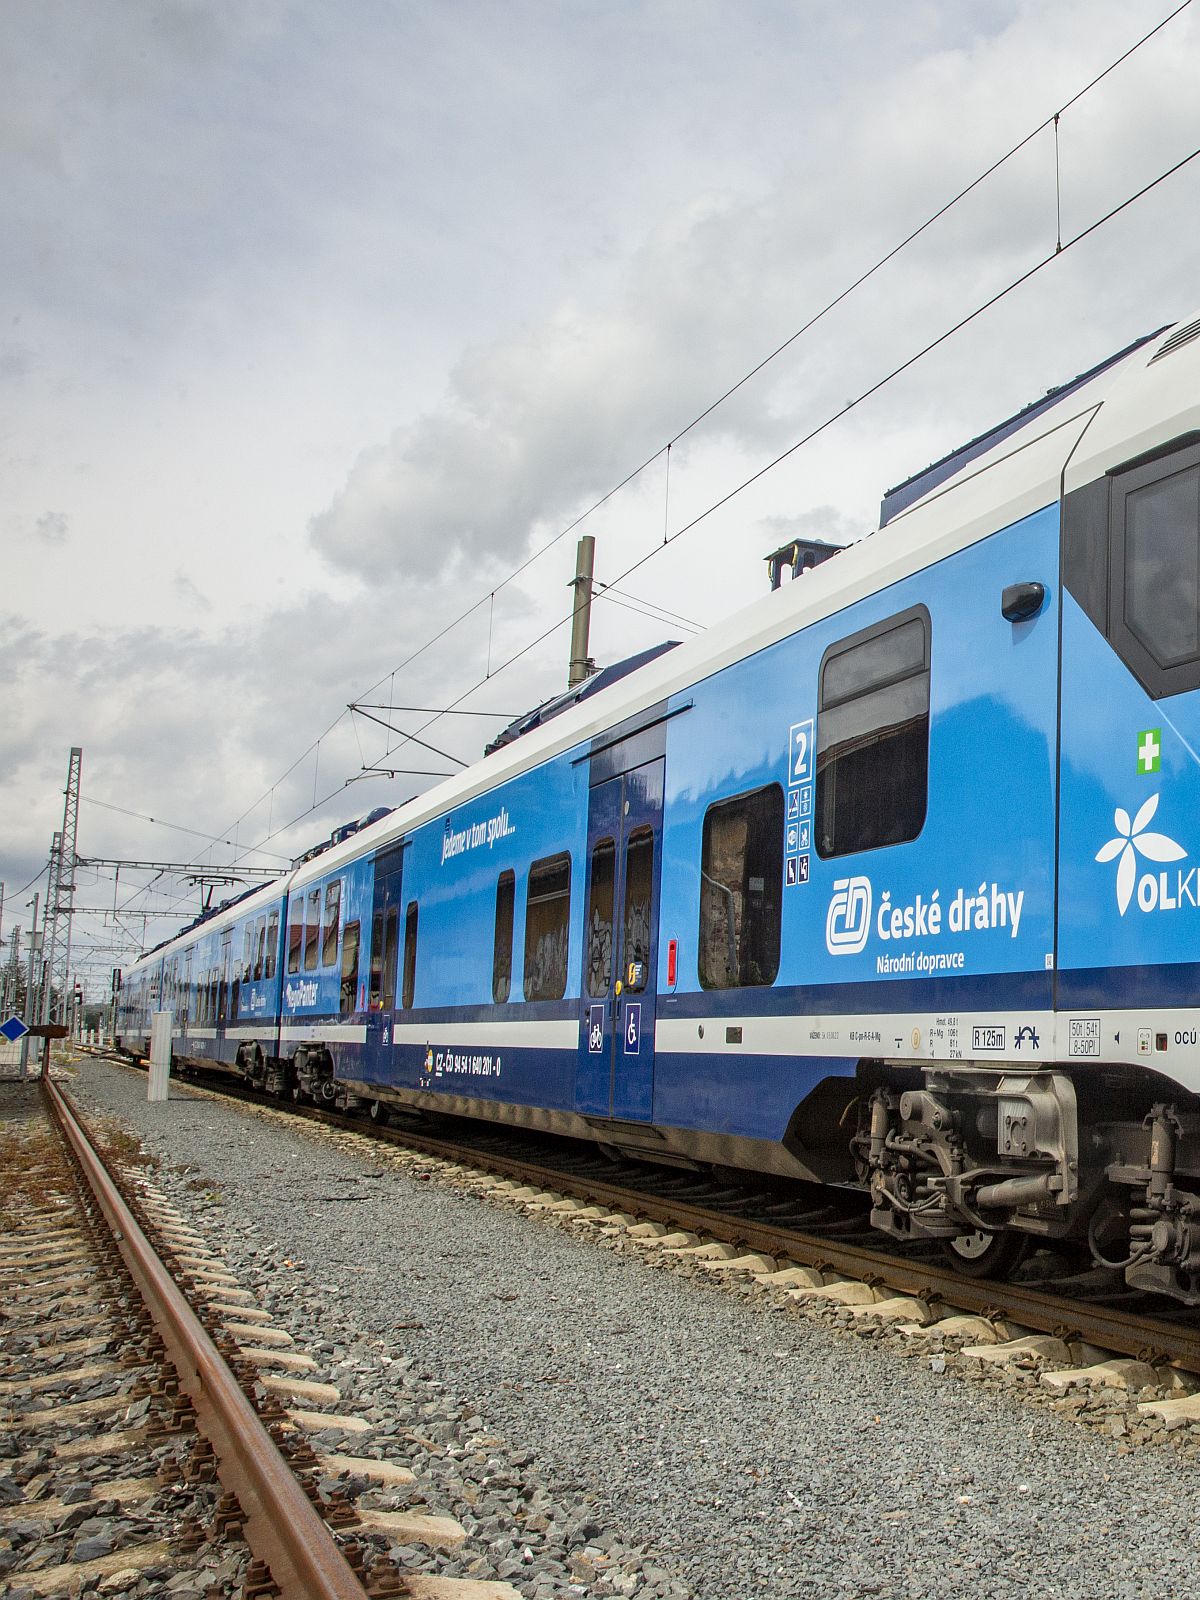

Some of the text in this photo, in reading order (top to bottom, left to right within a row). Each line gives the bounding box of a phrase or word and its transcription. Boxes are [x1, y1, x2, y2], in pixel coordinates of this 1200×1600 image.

[794, 731, 807, 776] 2
[471, 822, 487, 849] tom
[877, 881, 1025, 940] České dráhy
[877, 951, 965, 975] Národní dopravce
[974, 1030, 1003, 1047] R 125m
[1174, 1027, 1197, 1045] OCÚ
